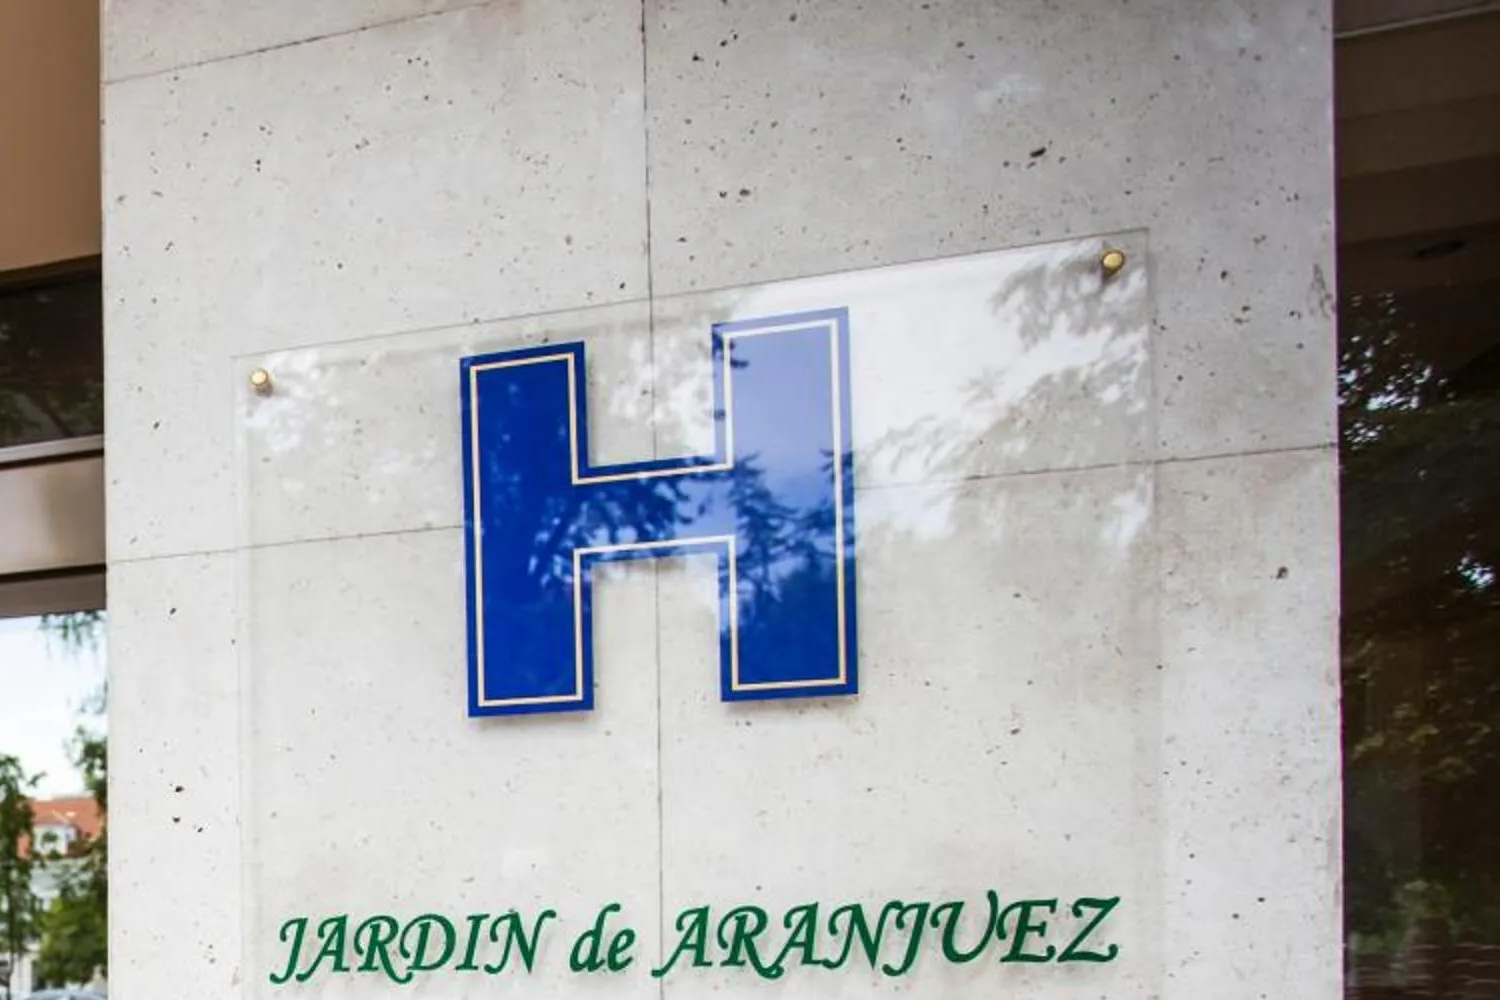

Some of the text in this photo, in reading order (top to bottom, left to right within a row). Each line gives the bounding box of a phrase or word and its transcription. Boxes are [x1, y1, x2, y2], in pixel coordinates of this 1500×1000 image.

[460, 307, 858, 717] H
[269, 890, 1122, 984] JARDIN de ARANJUEZ
